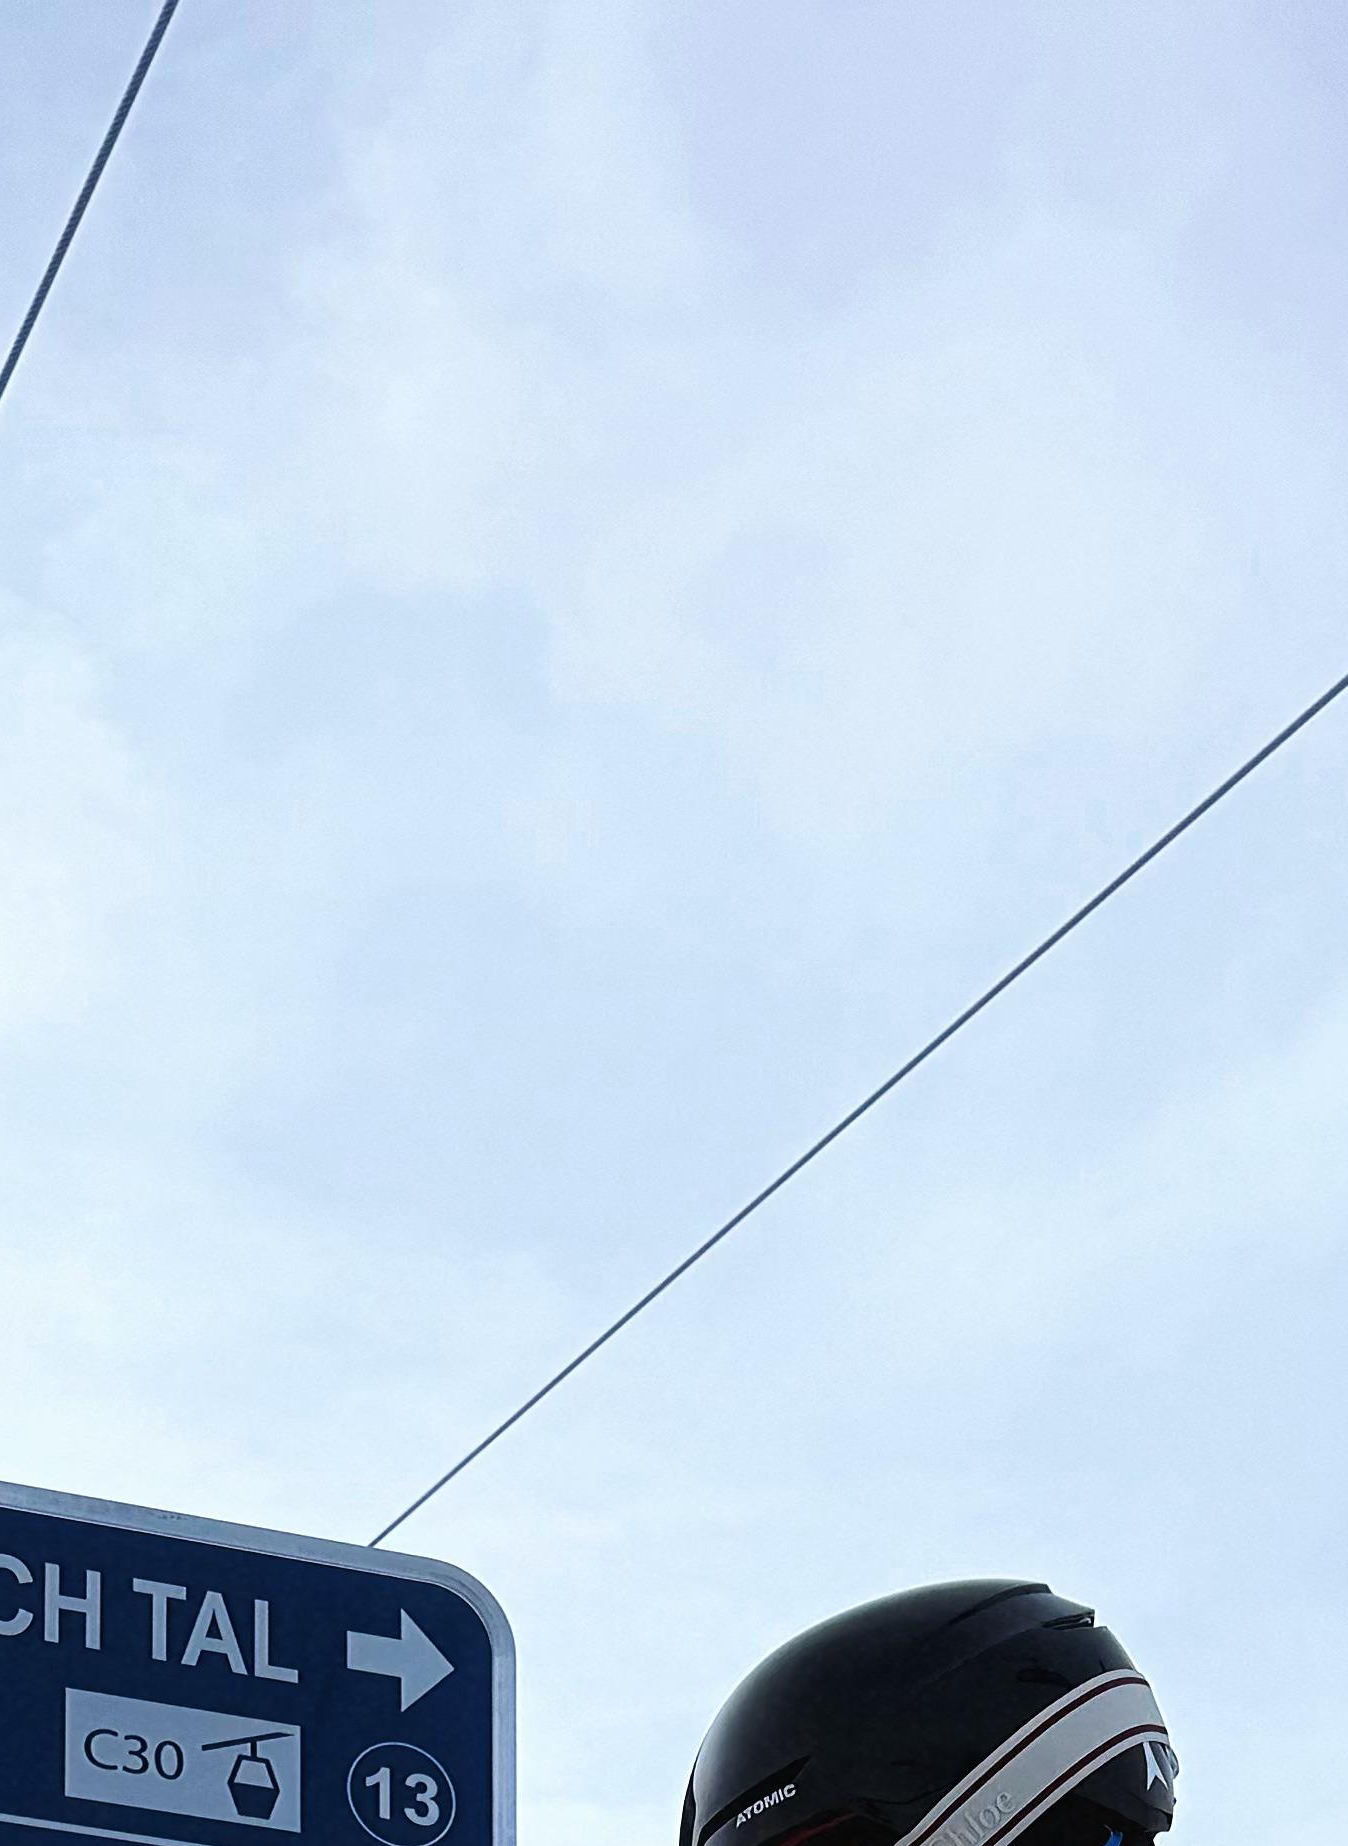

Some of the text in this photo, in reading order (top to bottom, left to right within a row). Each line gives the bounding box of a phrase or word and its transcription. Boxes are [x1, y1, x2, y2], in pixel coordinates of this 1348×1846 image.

[132, 1577, 299, 1684] TAL
[83, 1728, 184, 1781] C30
[365, 1766, 440, 1826] 13
[735, 1783, 797, 1829] ATOMIC
